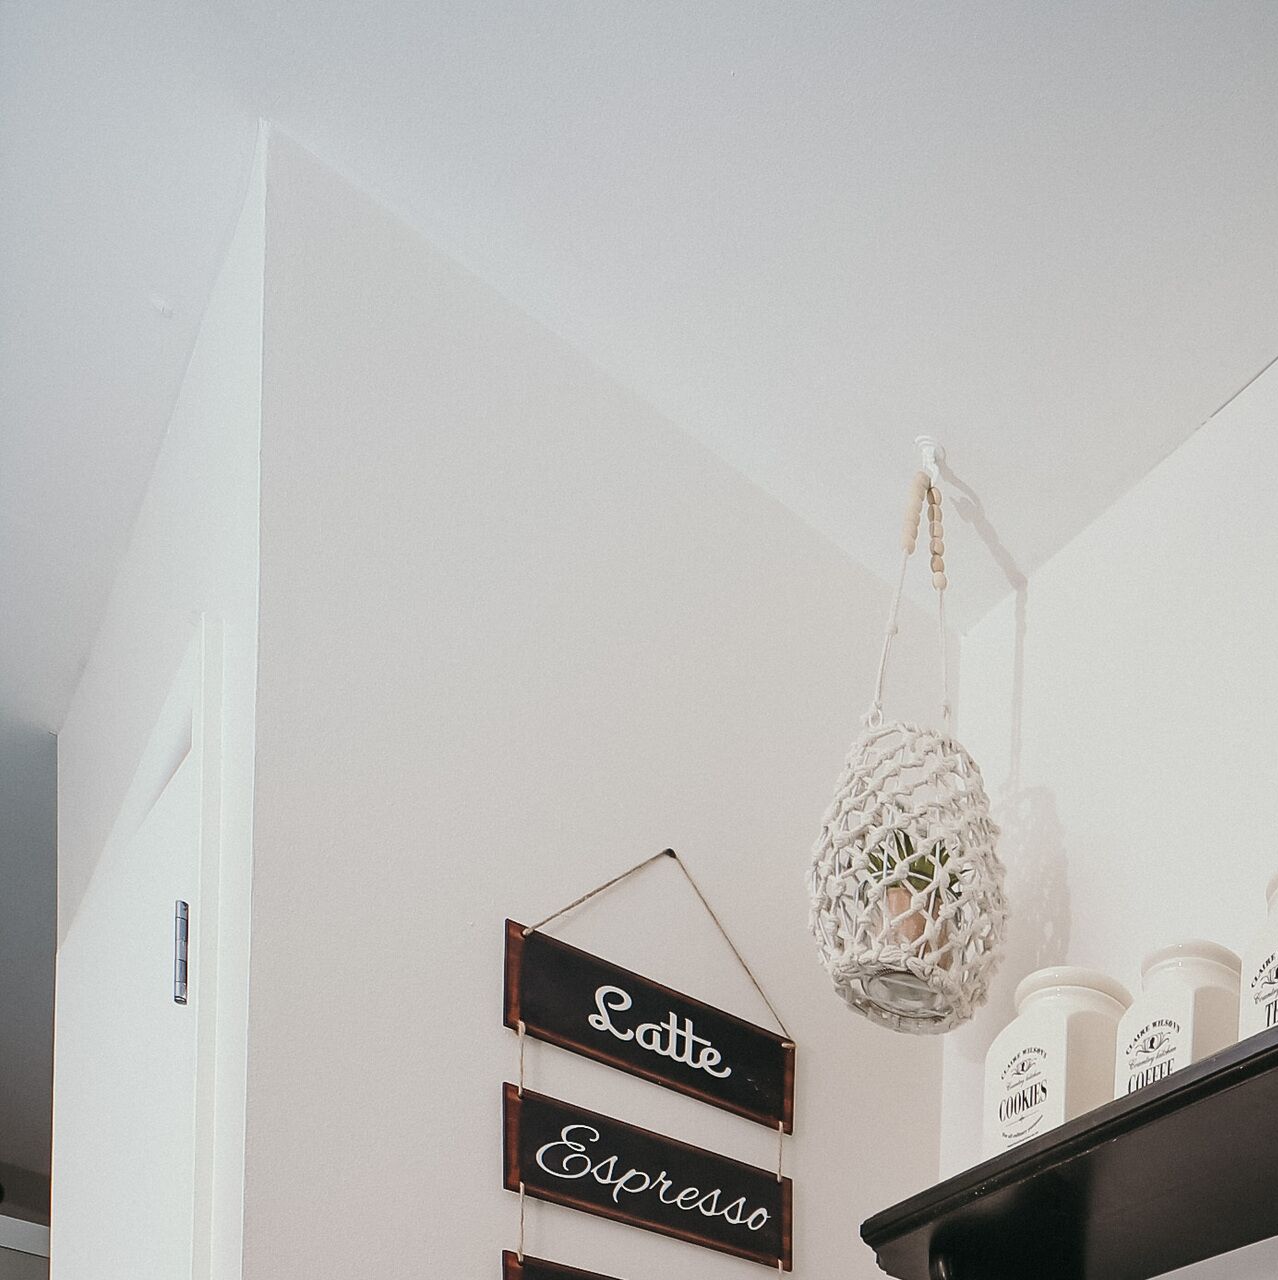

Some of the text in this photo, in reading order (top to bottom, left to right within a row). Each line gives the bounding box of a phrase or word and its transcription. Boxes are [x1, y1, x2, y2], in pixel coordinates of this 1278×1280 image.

[587, 985, 731, 1078] Latte
[999, 1079, 1048, 1122] COOKIES
[535, 1124, 771, 1231] Espresso
